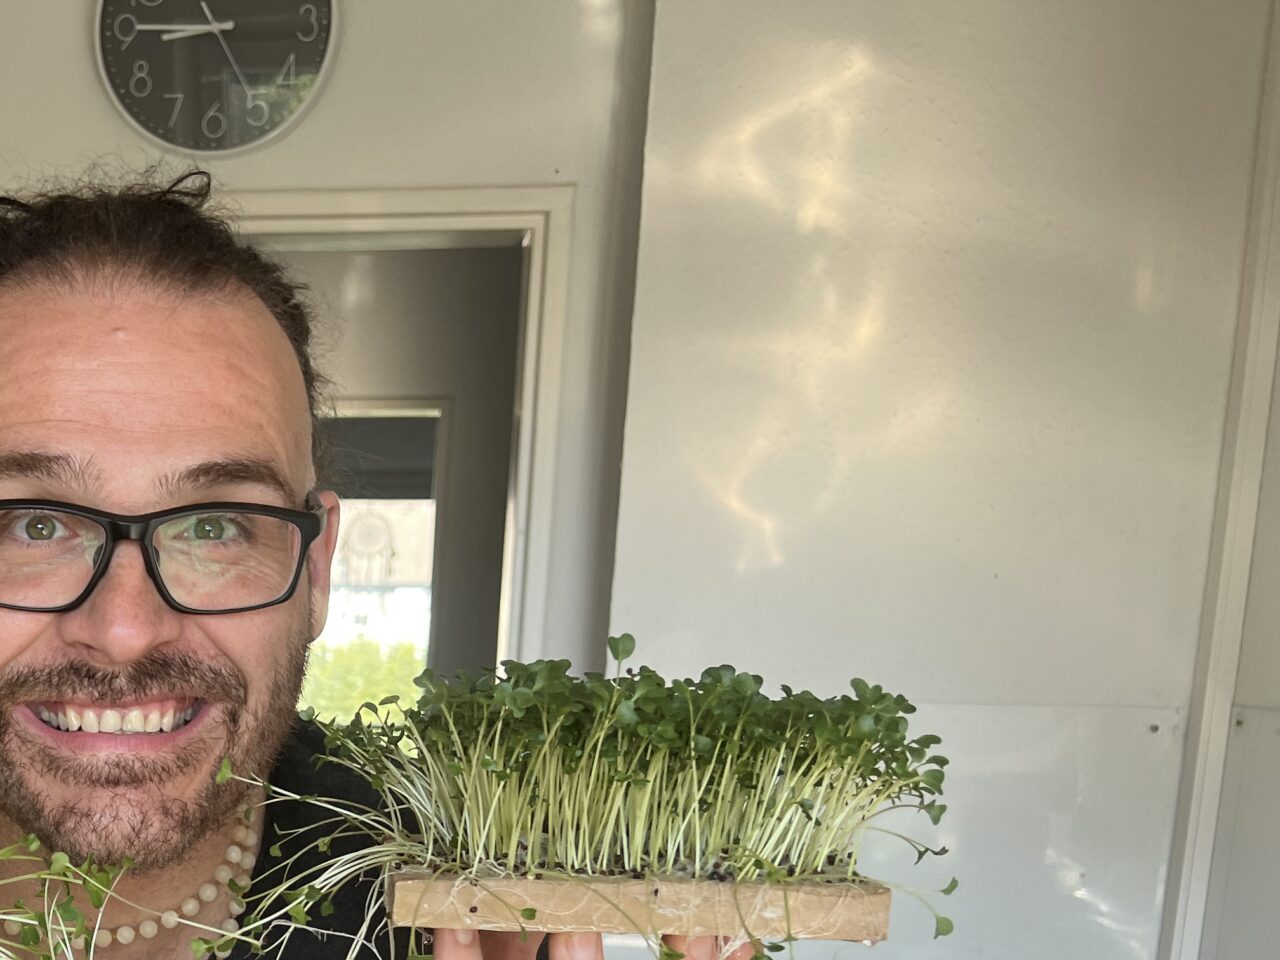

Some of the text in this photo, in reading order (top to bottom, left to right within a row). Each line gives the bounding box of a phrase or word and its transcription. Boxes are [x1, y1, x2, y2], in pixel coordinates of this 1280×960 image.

[114, 14, 138, 51] 9
[296, 4, 319, 42] 3
[129, 60, 153, 98] 8
[276, 53, 300, 89] 4
[163, 94, 185, 129] 7
[201, 102, 227, 139] 6
[246, 89, 270, 126] 5
